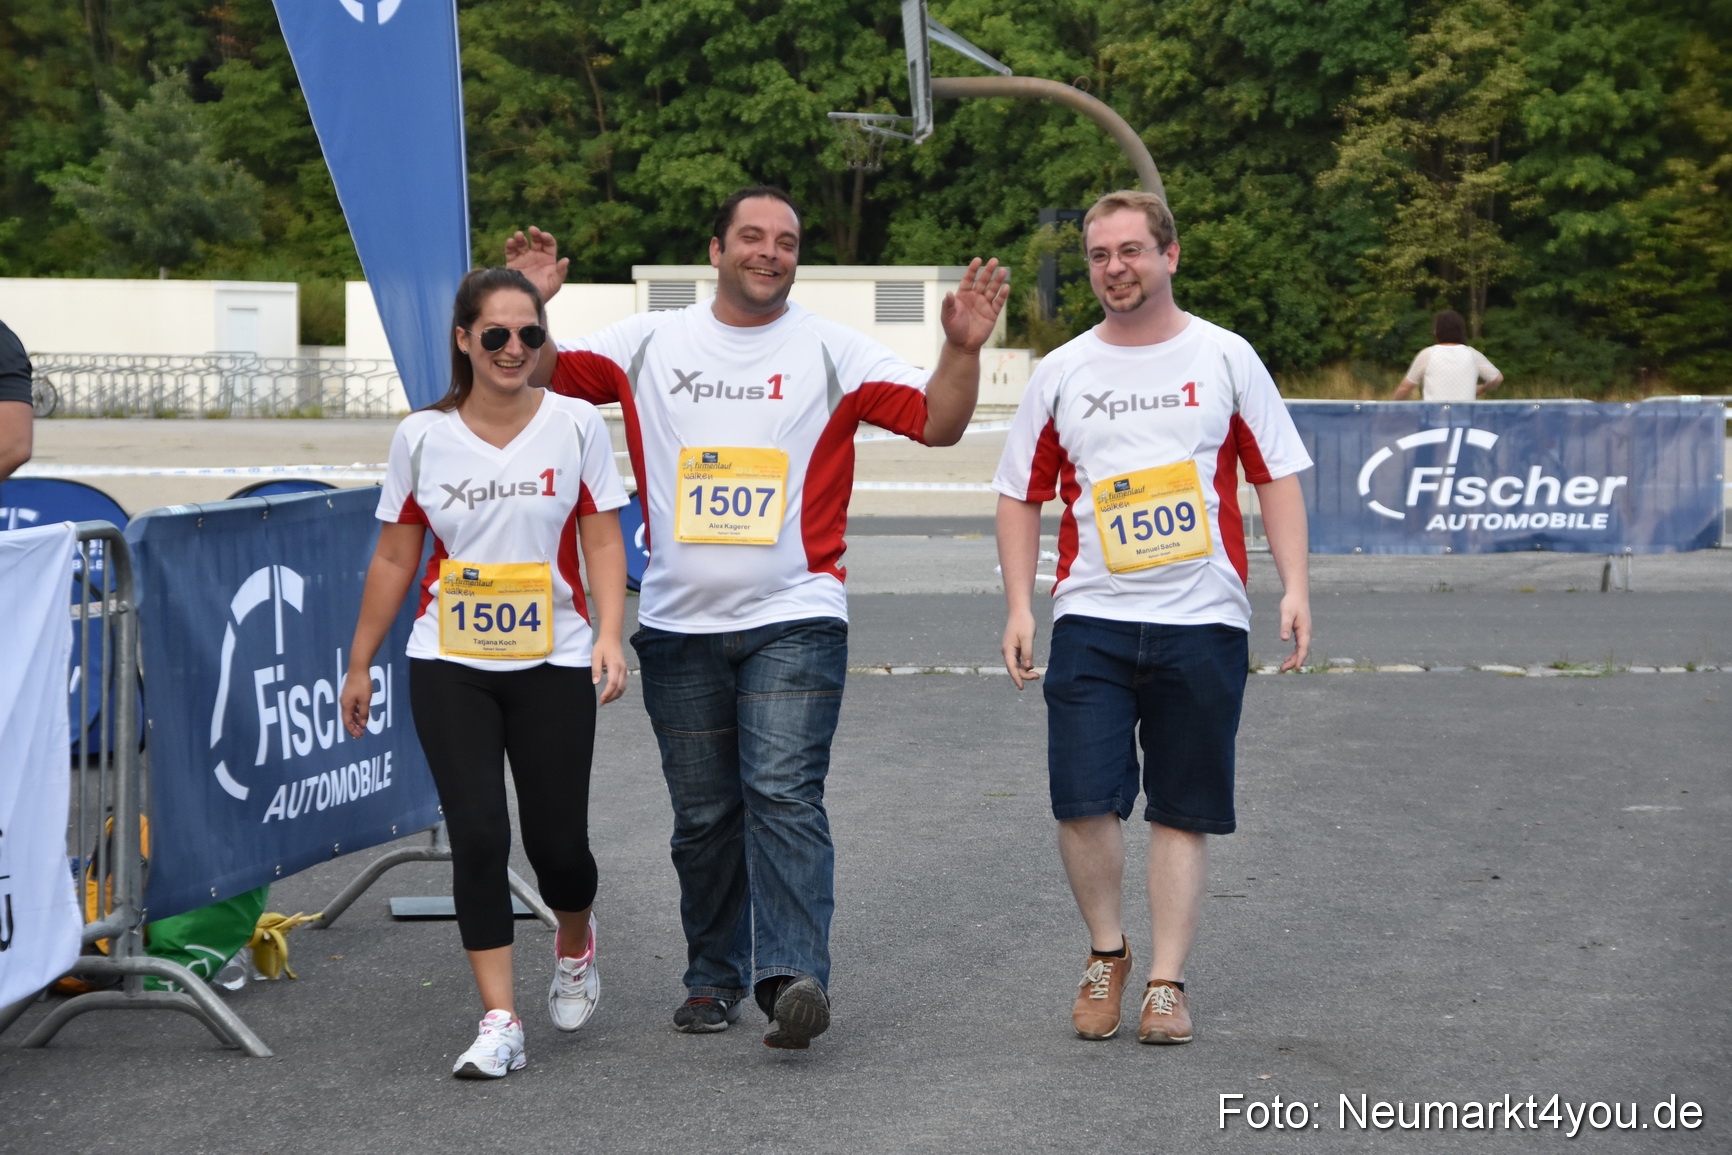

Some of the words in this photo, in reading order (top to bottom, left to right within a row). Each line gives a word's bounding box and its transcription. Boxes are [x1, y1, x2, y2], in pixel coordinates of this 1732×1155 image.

[689, 485, 776, 517] 1507
[1406, 465, 1628, 507] Fischer
[1110, 501, 1197, 545] 1509
[1425, 512, 1609, 531] AUTOMOBILE
[1136, 545, 1160, 555] Manuel
[1160, 541, 1181, 550] Sachs
[451, 601, 541, 633] 1504
[473, 638, 498, 646] Tatjana
[262, 751, 392, 824] AUTOMOBILE
